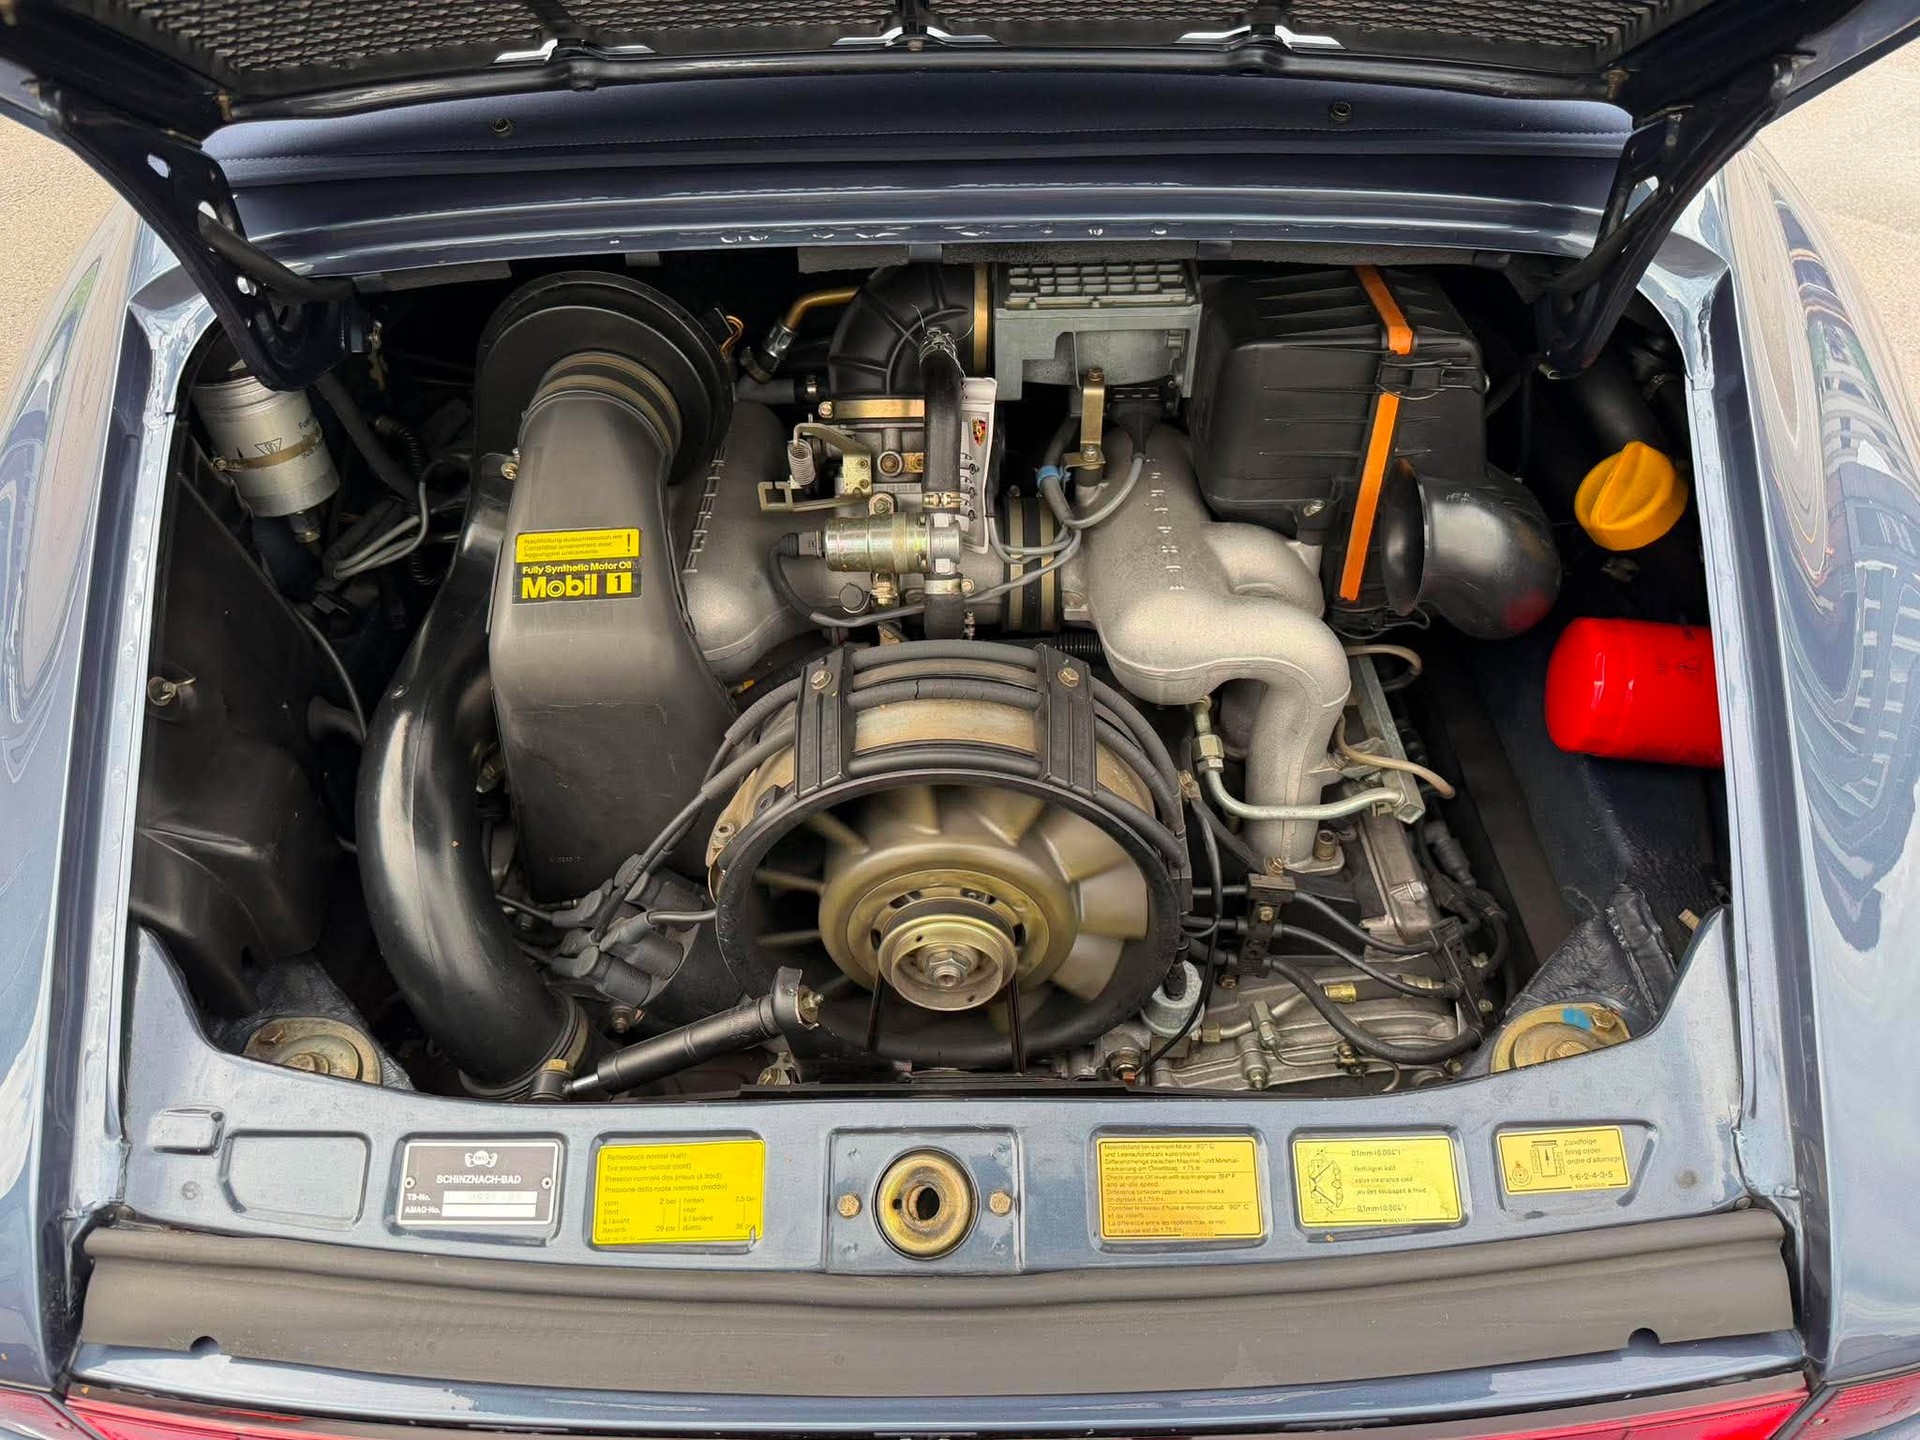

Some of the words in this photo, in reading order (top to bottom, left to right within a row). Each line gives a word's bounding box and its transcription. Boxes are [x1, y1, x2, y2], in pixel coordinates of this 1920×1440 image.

[523, 566, 544, 575] Fully
[545, 564, 589, 574] Synthetic
[590, 562, 617, 571] Motor
[618, 561, 632, 569] Oil
[522, 574, 597, 599] Mobil
[615, 575, 622, 592] 1
[436, 1175, 521, 1184] SCHINZNACH-BAD
